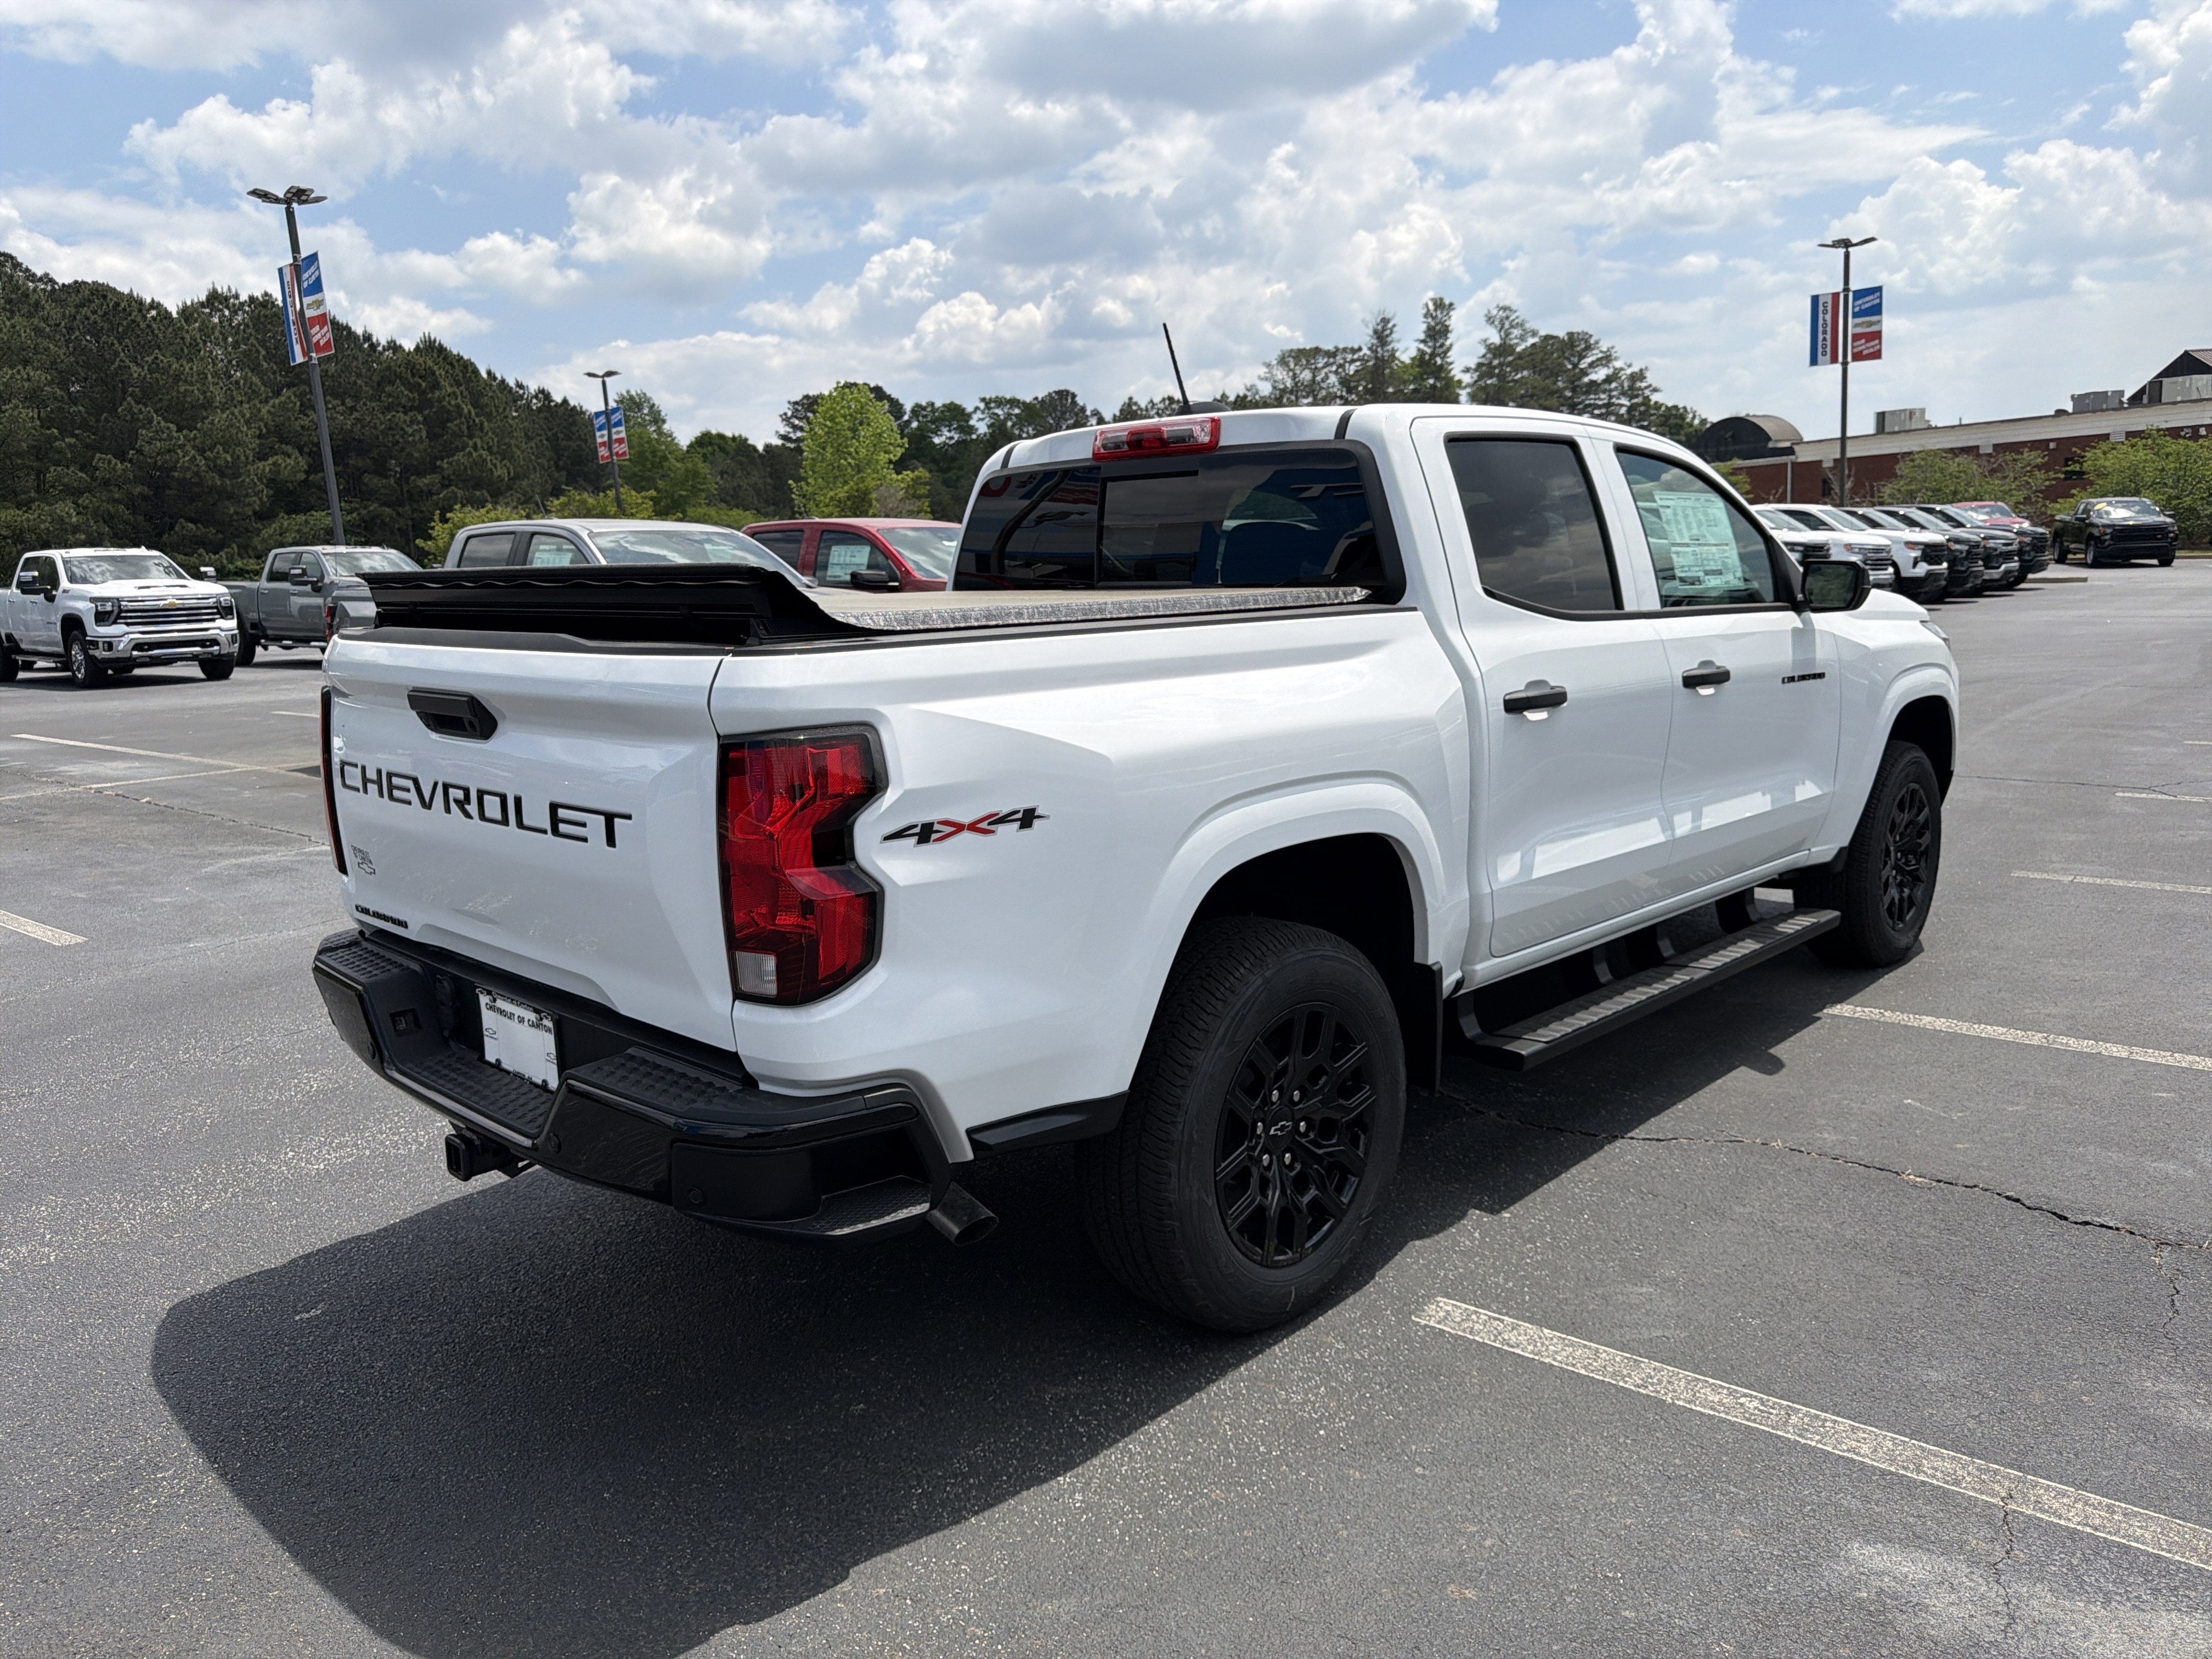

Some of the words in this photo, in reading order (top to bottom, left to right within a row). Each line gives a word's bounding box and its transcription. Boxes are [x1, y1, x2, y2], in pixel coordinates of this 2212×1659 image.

[340, 759, 633, 849] CHEVROLET
[485, 1002, 516, 1022] CHEVROLET
[517, 1015, 525, 1025] OF
[527, 1018, 553, 1035] CANTON
